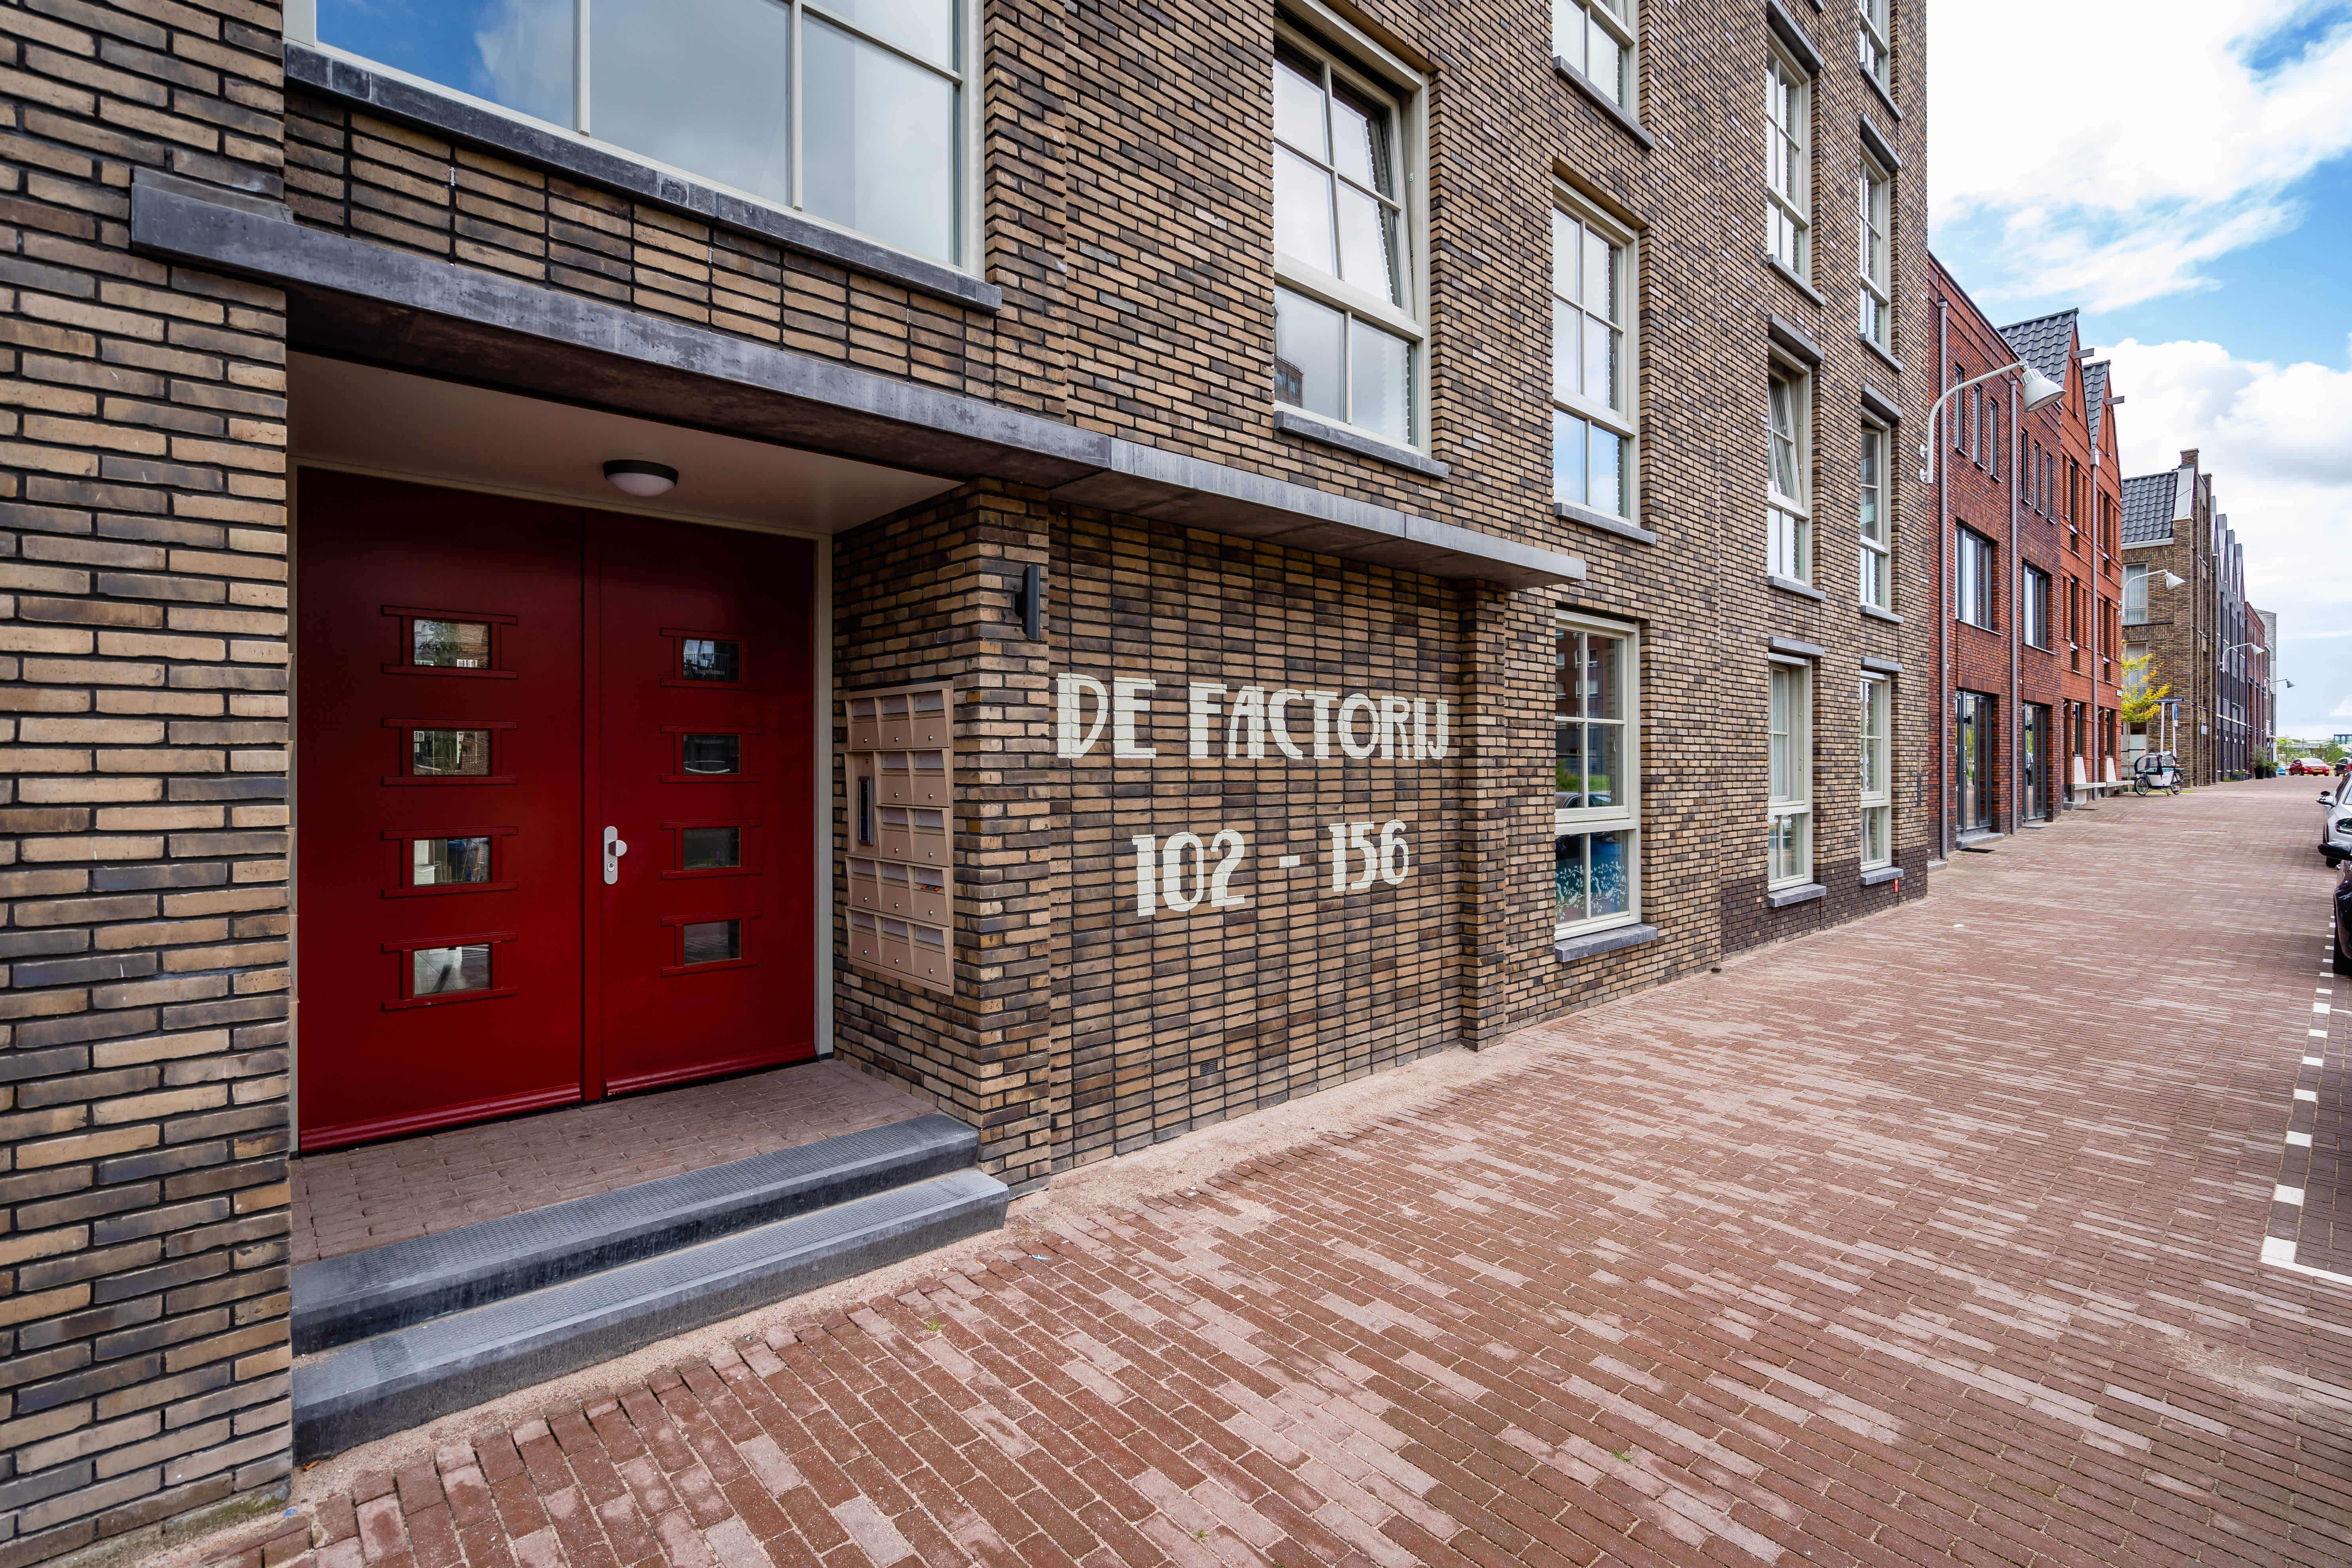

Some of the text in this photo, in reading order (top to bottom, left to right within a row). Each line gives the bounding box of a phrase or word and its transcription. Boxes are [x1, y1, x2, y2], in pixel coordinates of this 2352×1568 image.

[1056, 672, 1449, 761] DE FACTORIJ
[1131, 828, 1245, 917] 102
[1329, 819, 1409, 893] 156
